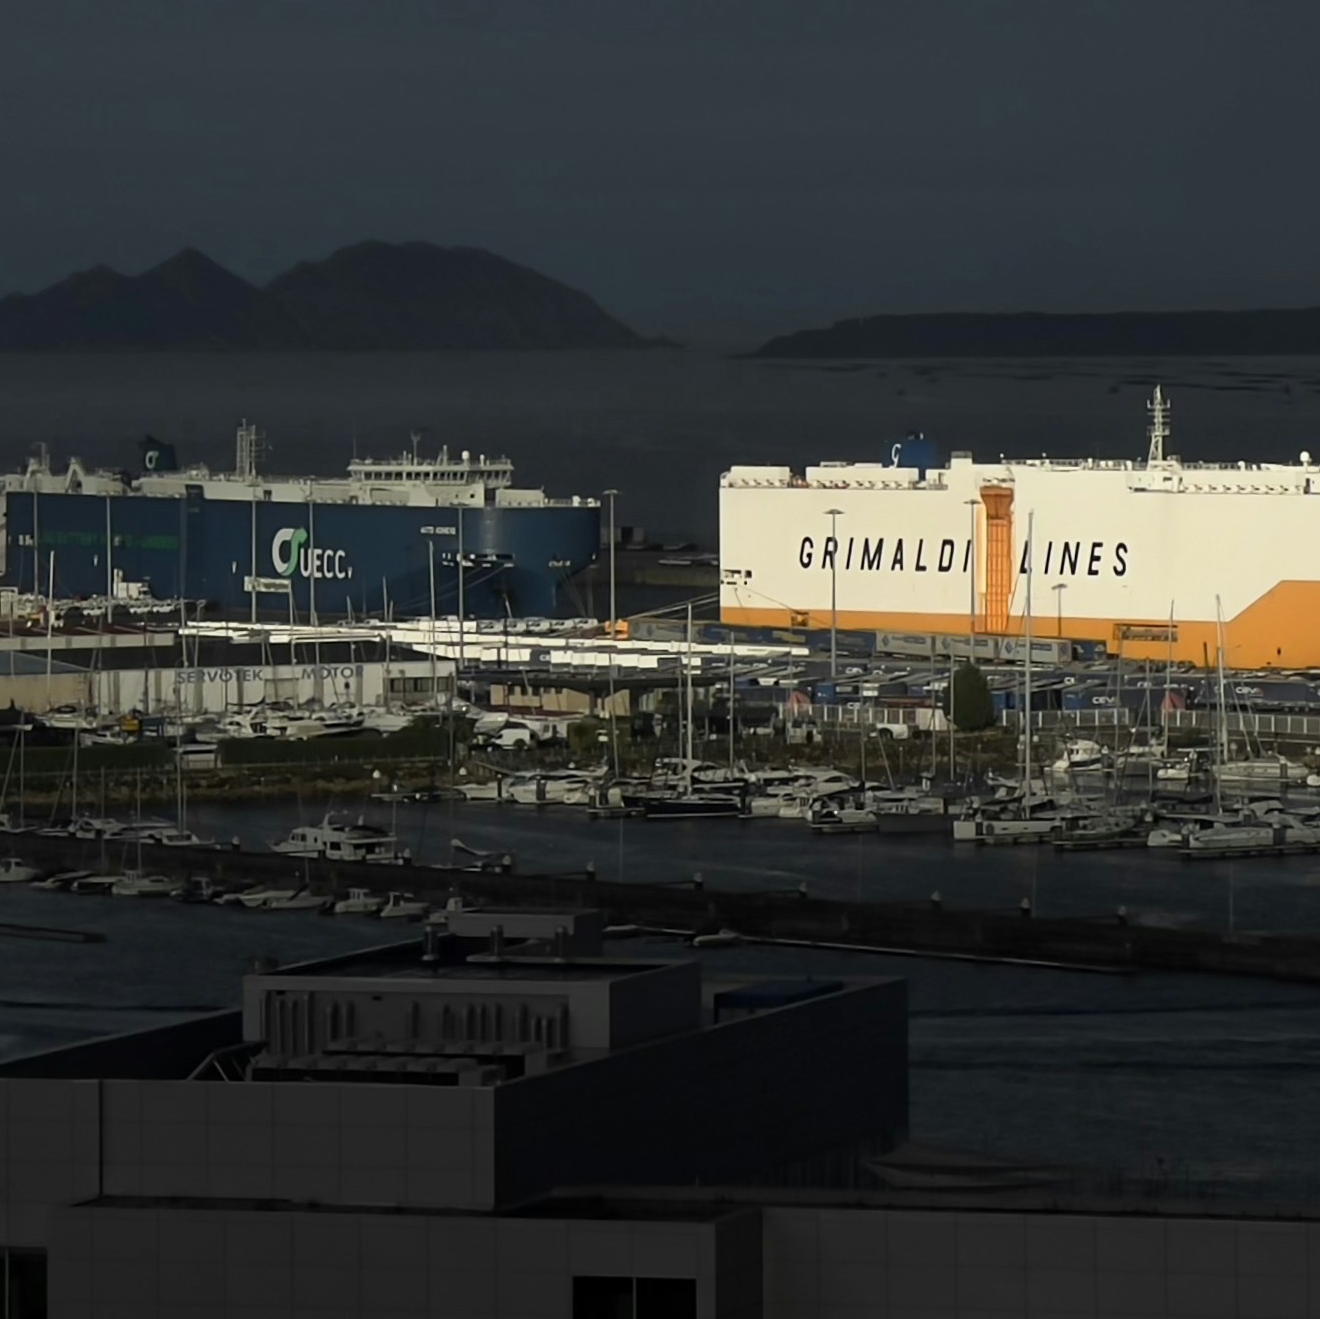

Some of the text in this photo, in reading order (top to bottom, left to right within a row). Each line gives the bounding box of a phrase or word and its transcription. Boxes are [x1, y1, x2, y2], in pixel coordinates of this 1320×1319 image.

[299, 547, 347, 579] UECC
[799, 536, 1129, 577] GRIMALDI LINES
[176, 668, 263, 683] SERVOTEK
